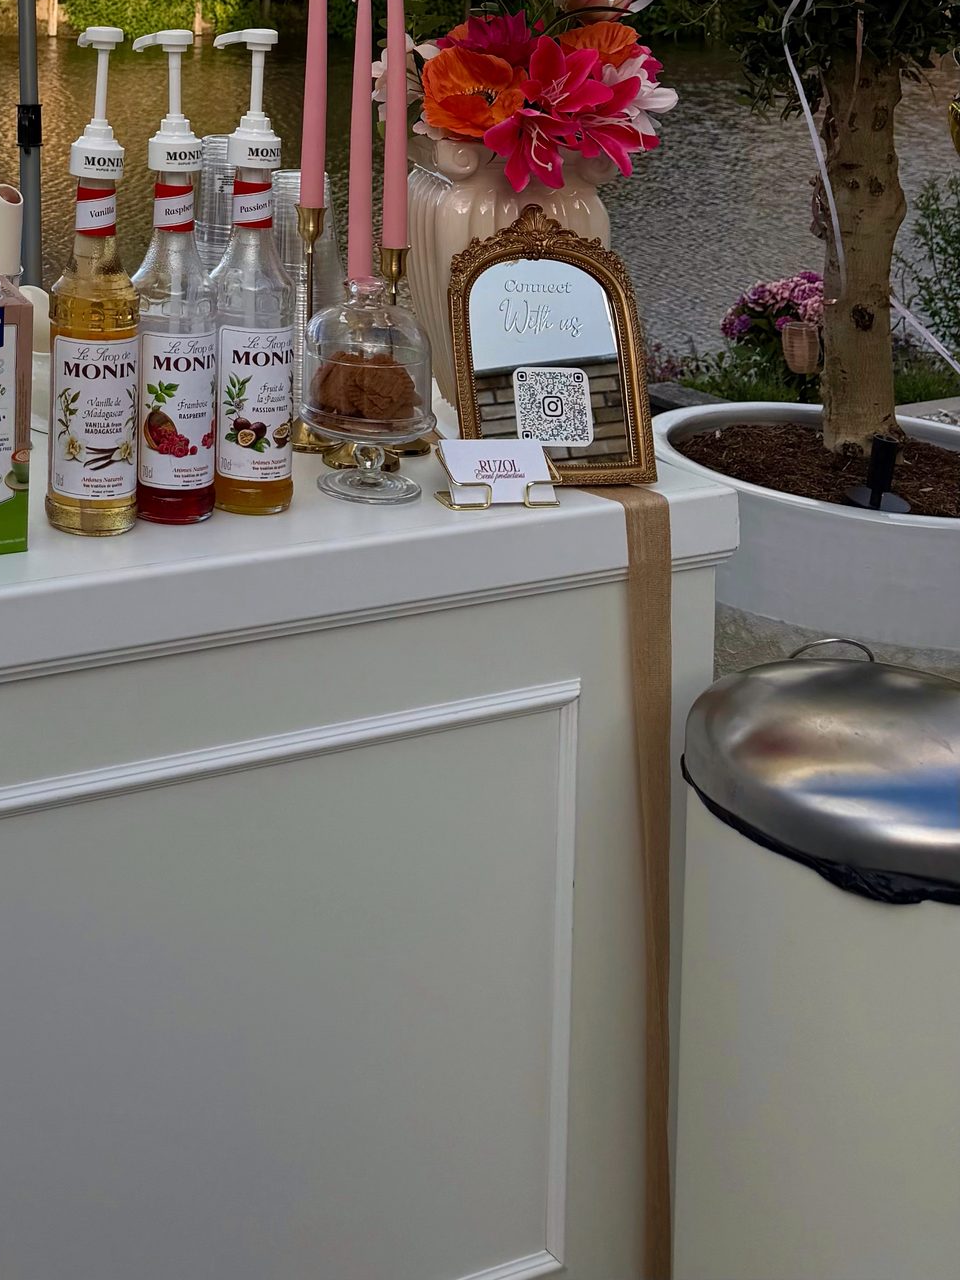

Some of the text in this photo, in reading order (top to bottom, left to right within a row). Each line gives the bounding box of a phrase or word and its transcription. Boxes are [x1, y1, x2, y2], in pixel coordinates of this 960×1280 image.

[89, 206, 114, 218] Vanilla
[240, 203, 267, 213] Passion
[504, 279, 572, 293] Connect
[499, 299, 583, 337] With us
[163, 341, 180, 354] Le
[183, 340, 208, 356] Sirop
[243, 336, 259, 349] Le
[262, 336, 286, 351] Sirop
[72, 348, 131, 364] Le Sirop de
[153, 354, 216, 372] MONIN
[232, 349, 294, 366] MONIN
[64, 361, 136, 379] MONIN
[260, 383, 278, 394] Fruit
[87, 397, 121, 407] Vanille de
[177, 399, 208, 411] Framboise
[257, 394, 286, 405] la Passion
[82, 410, 123, 420] Madagascar
[479, 460, 520, 472] RUZOL
[474, 469, 525, 483] Event productions
